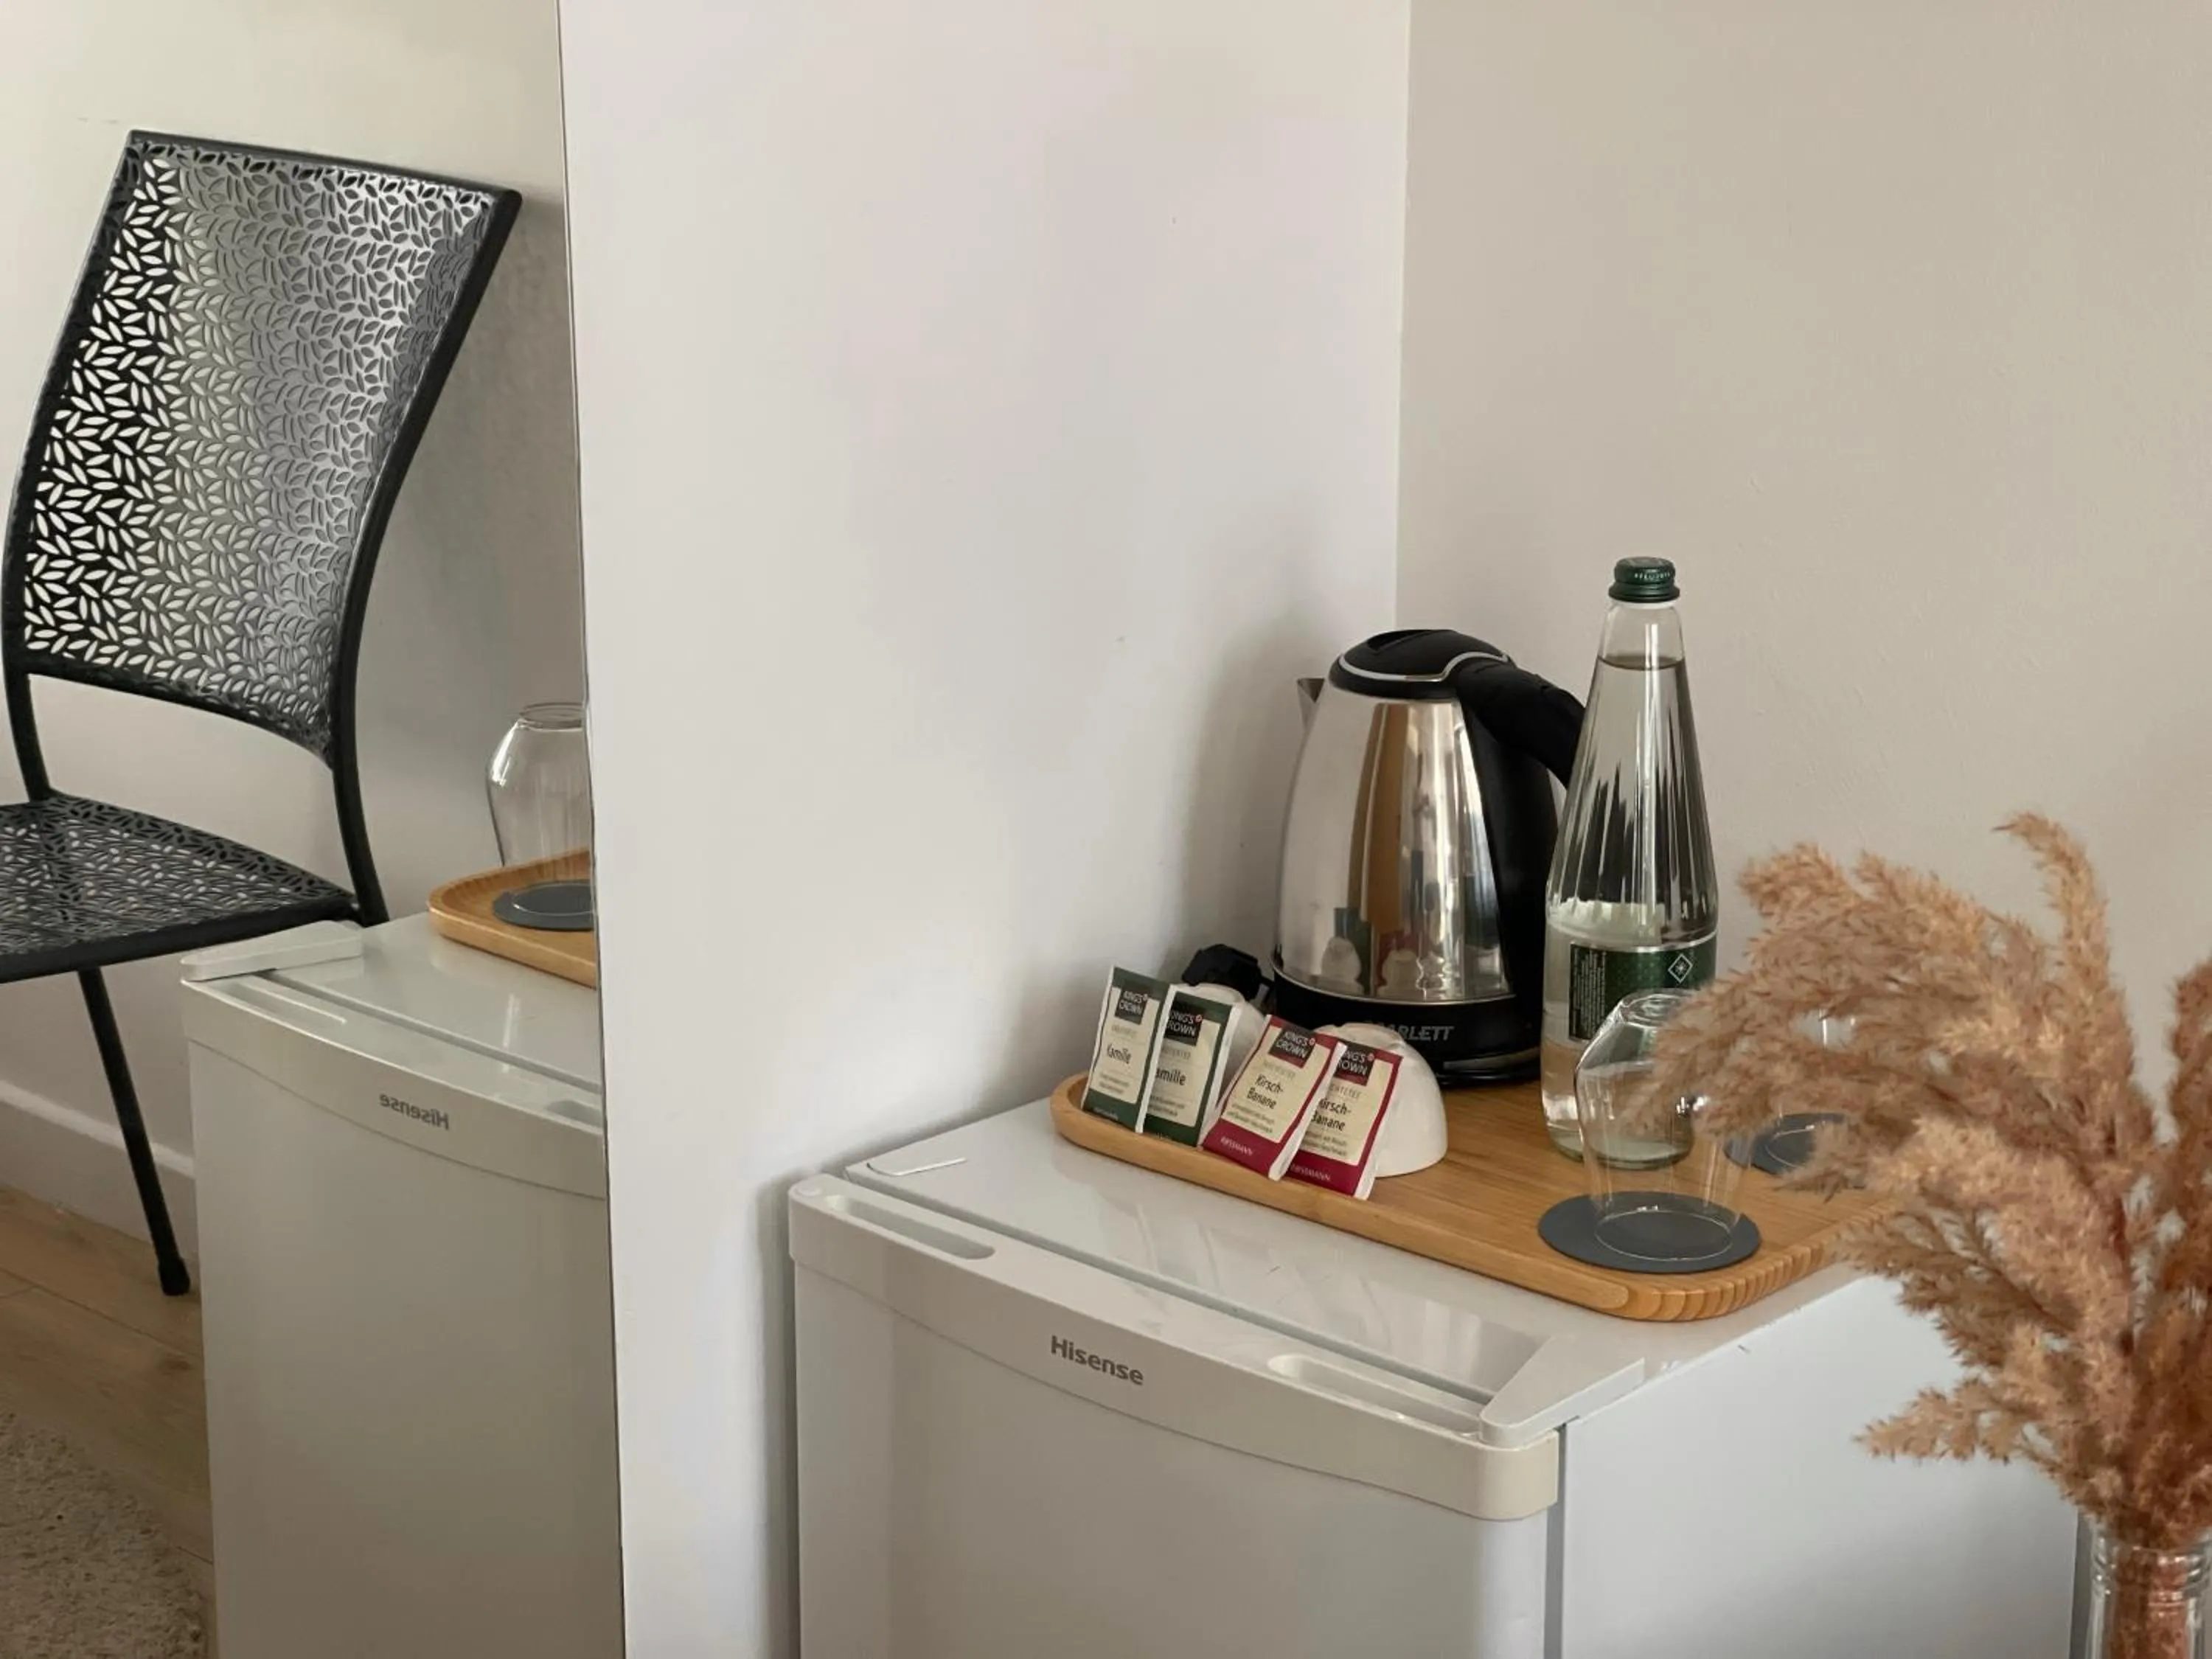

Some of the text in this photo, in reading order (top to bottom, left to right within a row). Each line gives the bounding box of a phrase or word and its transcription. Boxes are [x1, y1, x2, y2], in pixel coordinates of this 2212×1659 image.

[1167, 1021, 1196, 1036] ROWN
[1155, 1068, 1186, 1086] amille
[1247, 1087, 1277, 1110] Banane
[1051, 1335, 1144, 1386] Hisense
